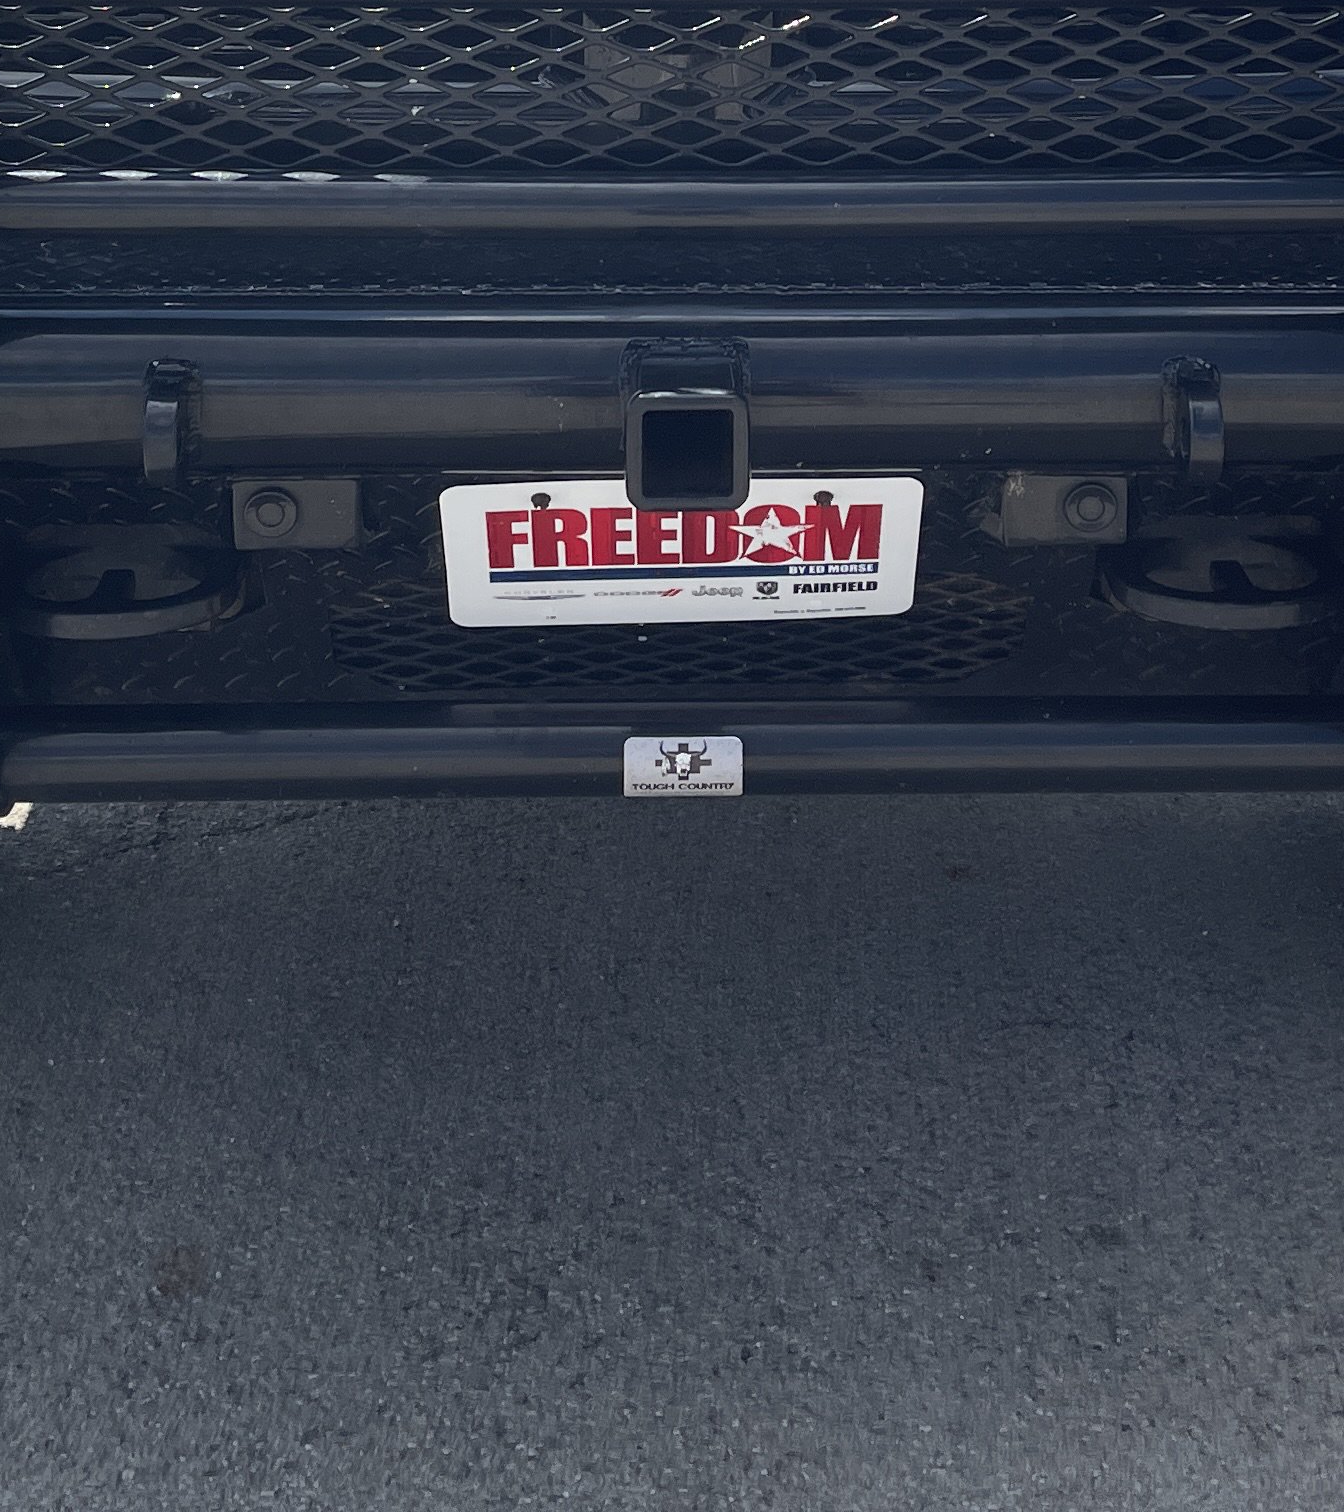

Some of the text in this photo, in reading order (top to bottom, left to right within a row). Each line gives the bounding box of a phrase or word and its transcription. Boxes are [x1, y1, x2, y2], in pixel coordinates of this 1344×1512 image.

[485, 504, 883, 568] FREEDOM
[788, 563, 874, 575] BY ED MORSE
[793, 581, 878, 594] FAIRFIELD
[678, 782, 735, 790] COUNTRY
